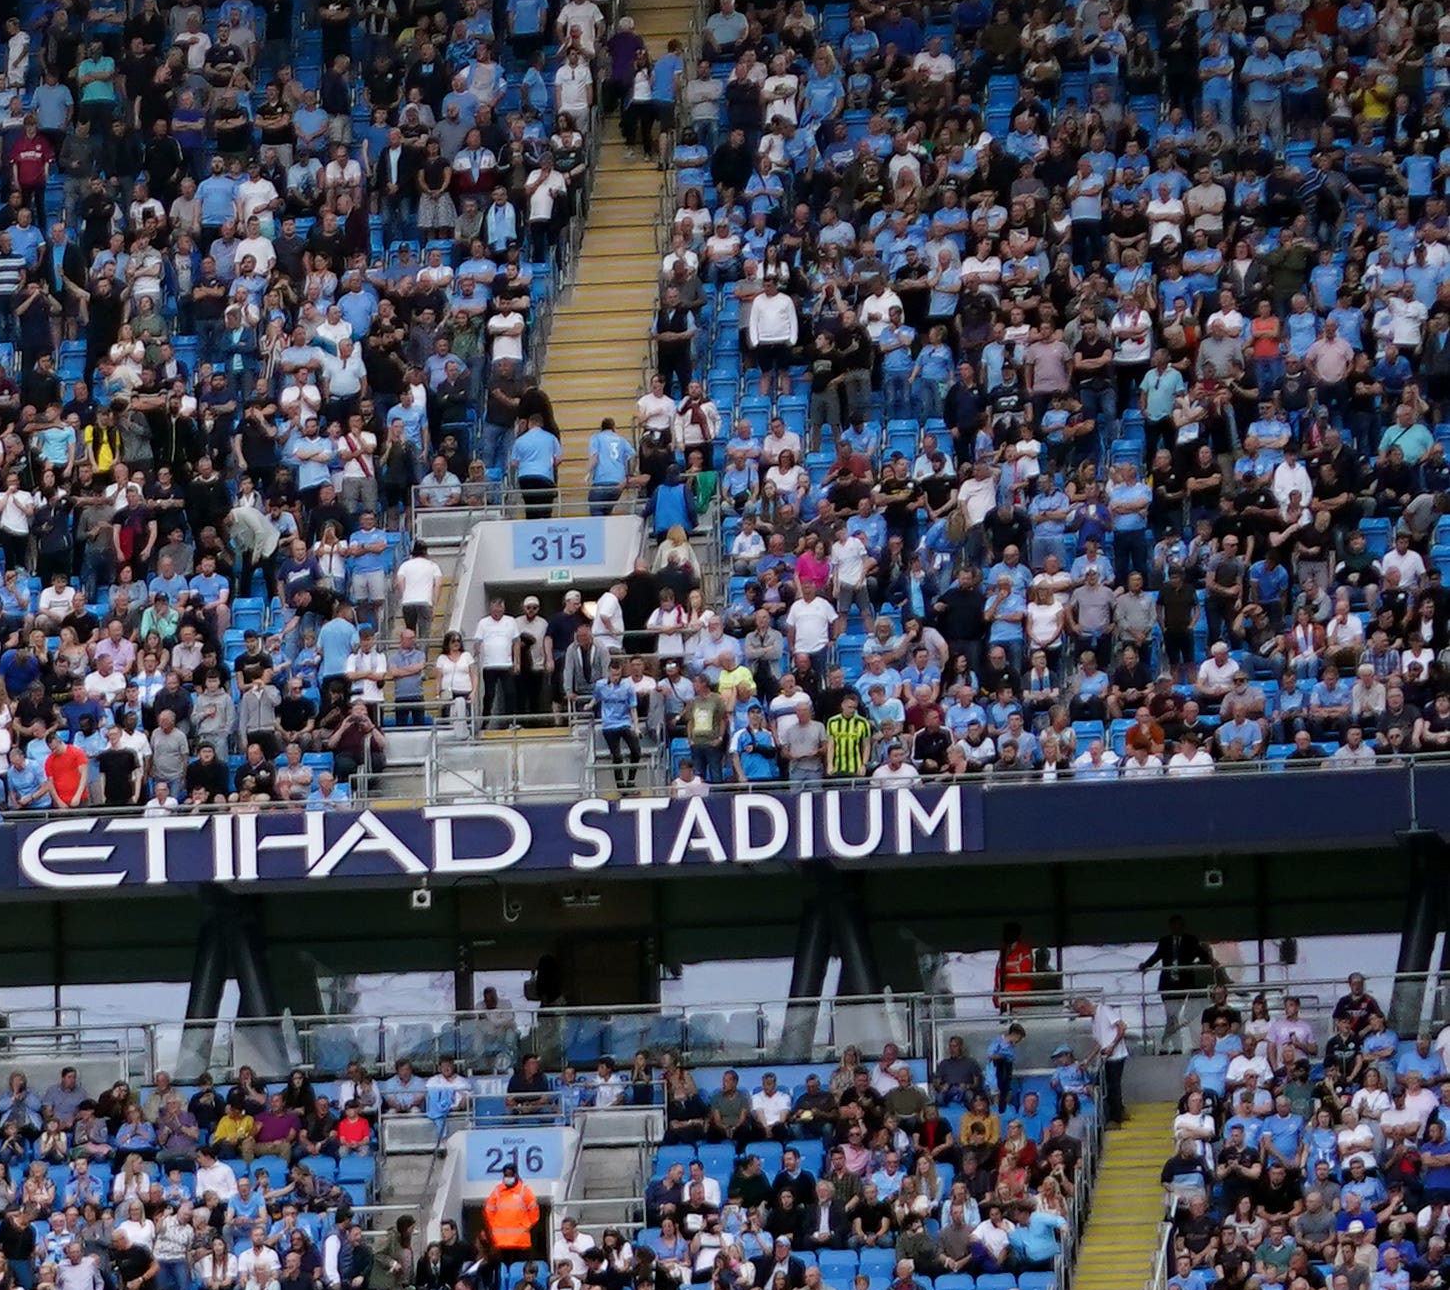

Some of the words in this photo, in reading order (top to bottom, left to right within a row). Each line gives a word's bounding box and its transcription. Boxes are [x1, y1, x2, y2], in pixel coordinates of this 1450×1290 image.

[531, 535, 586, 561] 315
[18, 803, 533, 889] ETIHAD
[566, 784, 964, 870] STADIUM
[486, 1146, 543, 1173] 216
